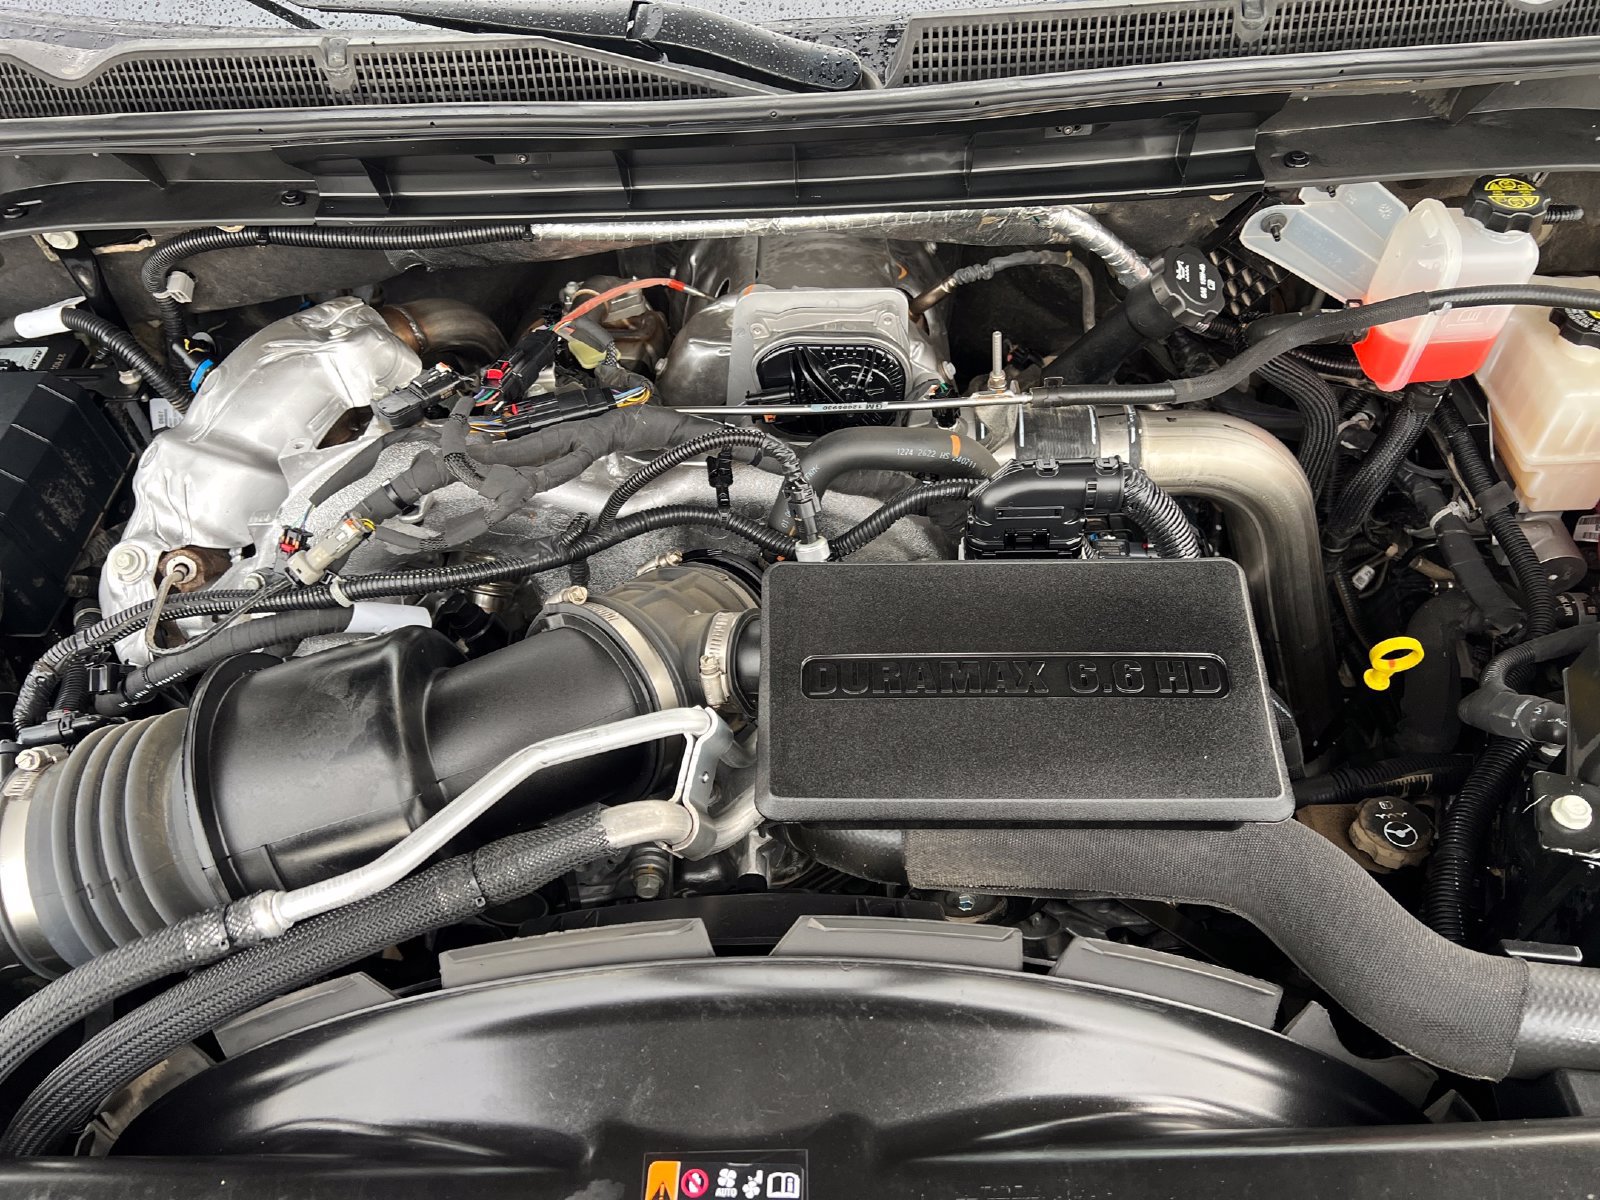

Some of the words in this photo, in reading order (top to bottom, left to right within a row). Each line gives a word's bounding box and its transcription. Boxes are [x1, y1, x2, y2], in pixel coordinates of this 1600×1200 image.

[808, 661, 1050, 695] DURAMAX
[1068, 660, 1146, 695] 6.6
[1155, 660, 1227, 694] HD
[715, 1187, 738, 1198] AUTO
